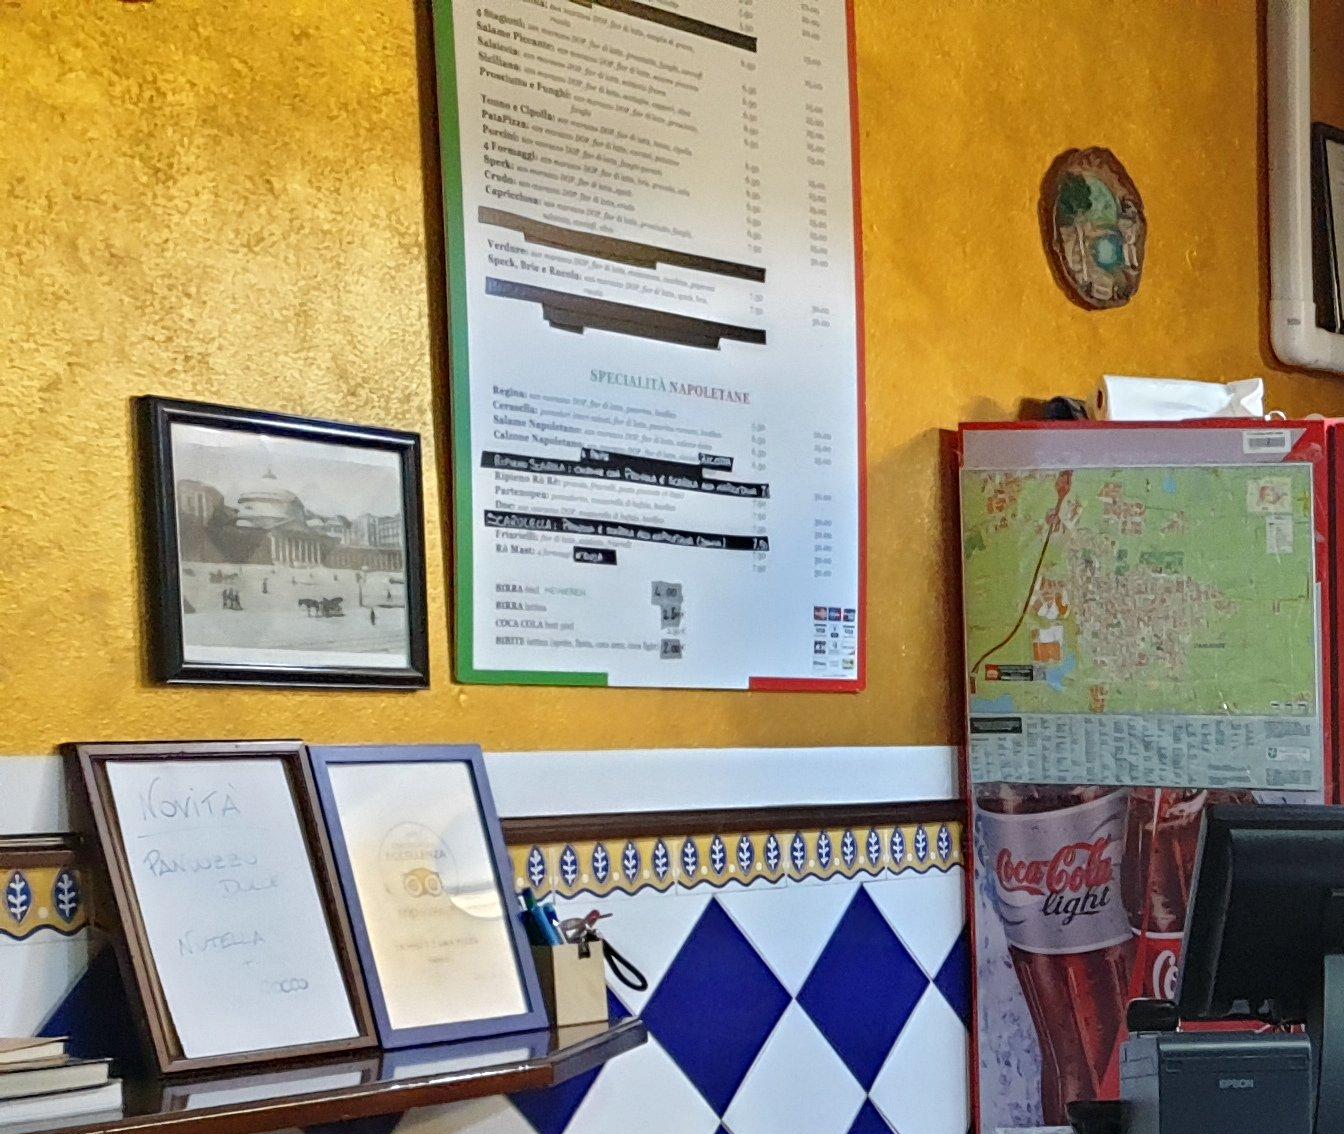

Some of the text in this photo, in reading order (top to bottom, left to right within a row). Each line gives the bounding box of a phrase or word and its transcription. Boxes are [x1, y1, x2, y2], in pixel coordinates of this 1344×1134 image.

[670, 381, 750, 405] NAPOLETANE
[997, 833, 1113, 896] Coca-Cola
[1041, 886, 1110, 925] light
[1219, 1079, 1254, 1089] EPSON
